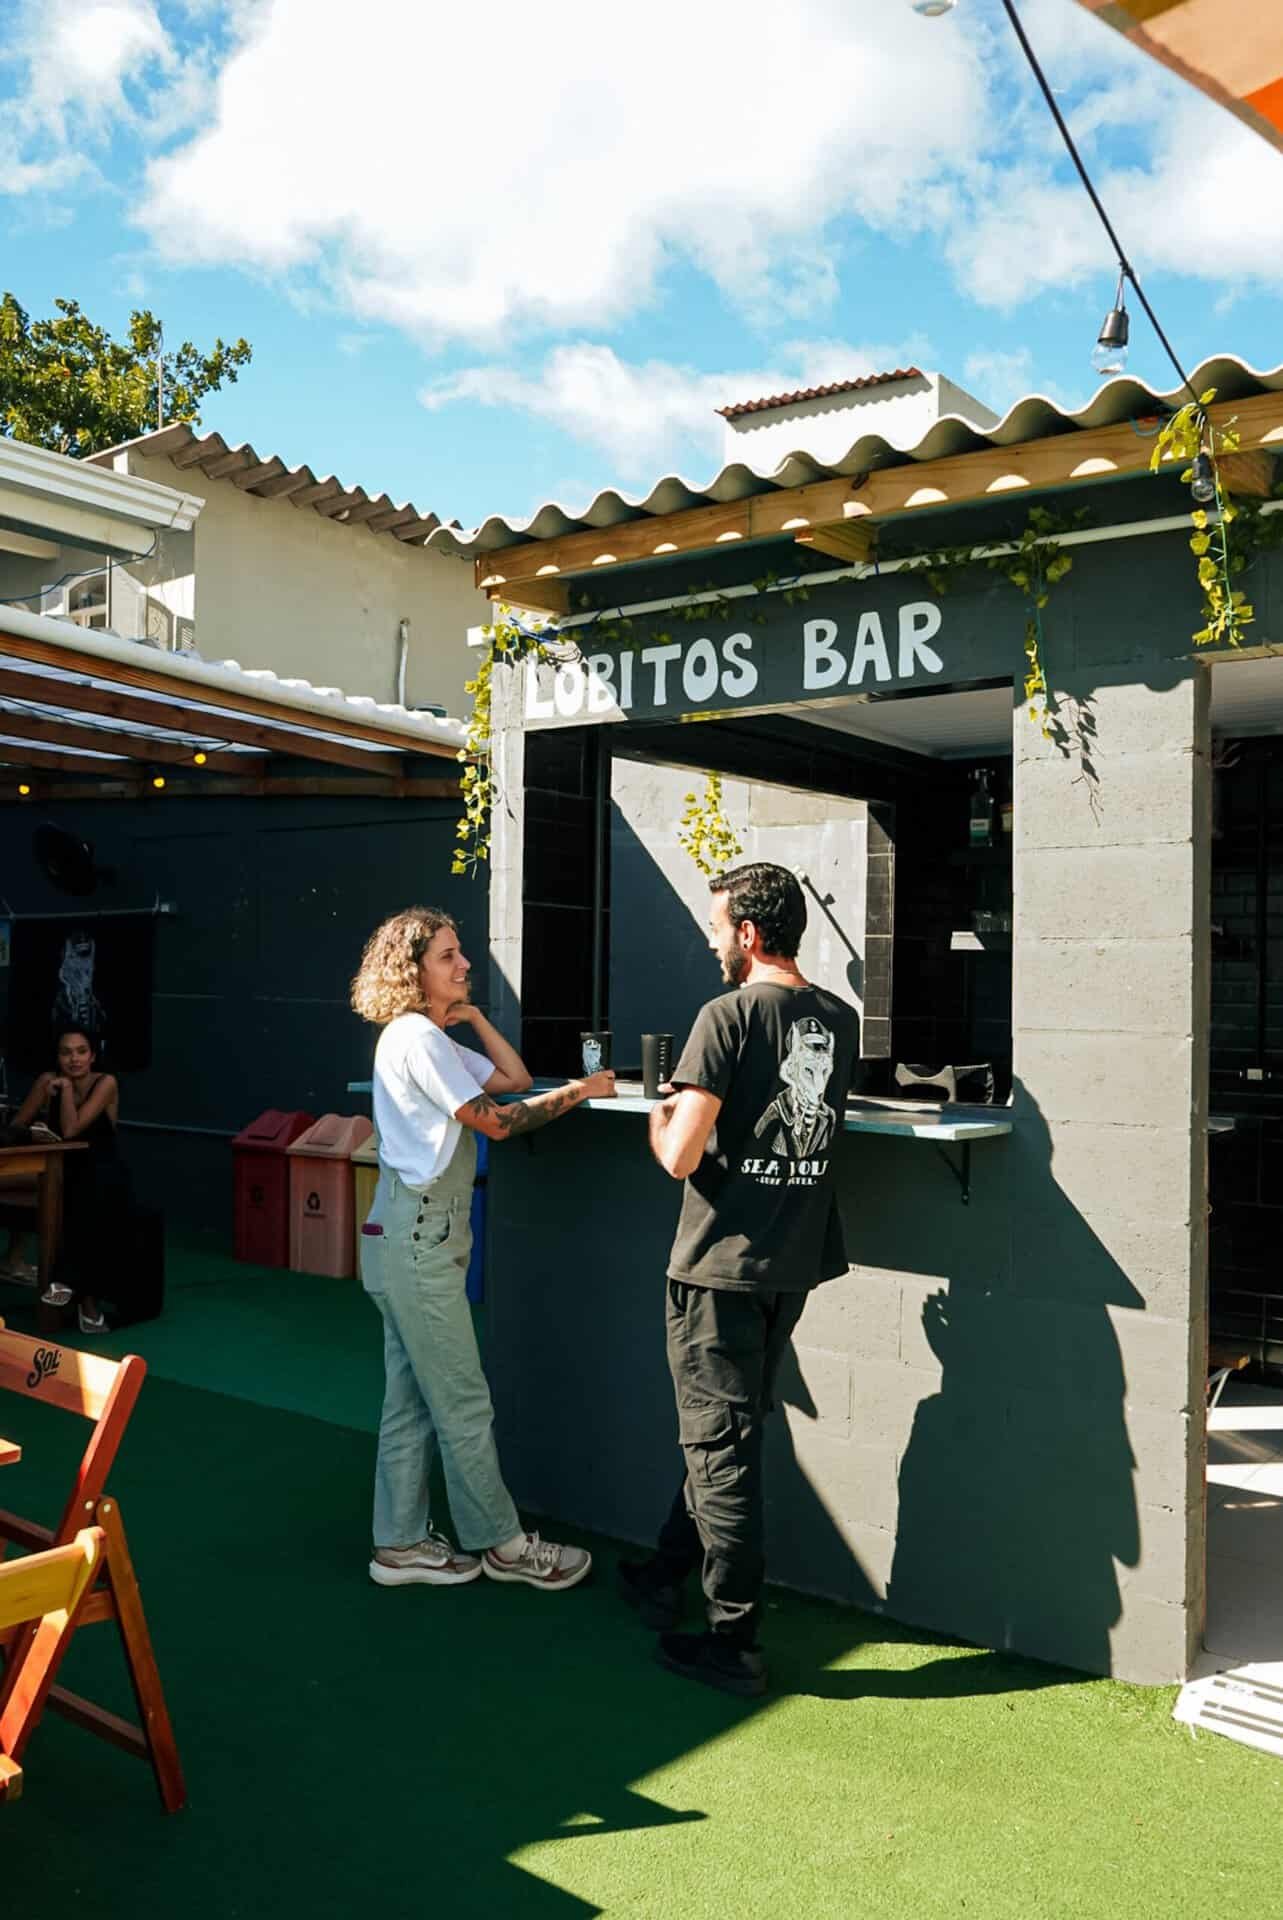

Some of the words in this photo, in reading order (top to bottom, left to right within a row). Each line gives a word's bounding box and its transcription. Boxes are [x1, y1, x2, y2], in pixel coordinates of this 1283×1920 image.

[525, 632, 758, 719] LOBITOS
[803, 601, 944, 690] BAR
[741, 1158, 780, 1176] SEA
